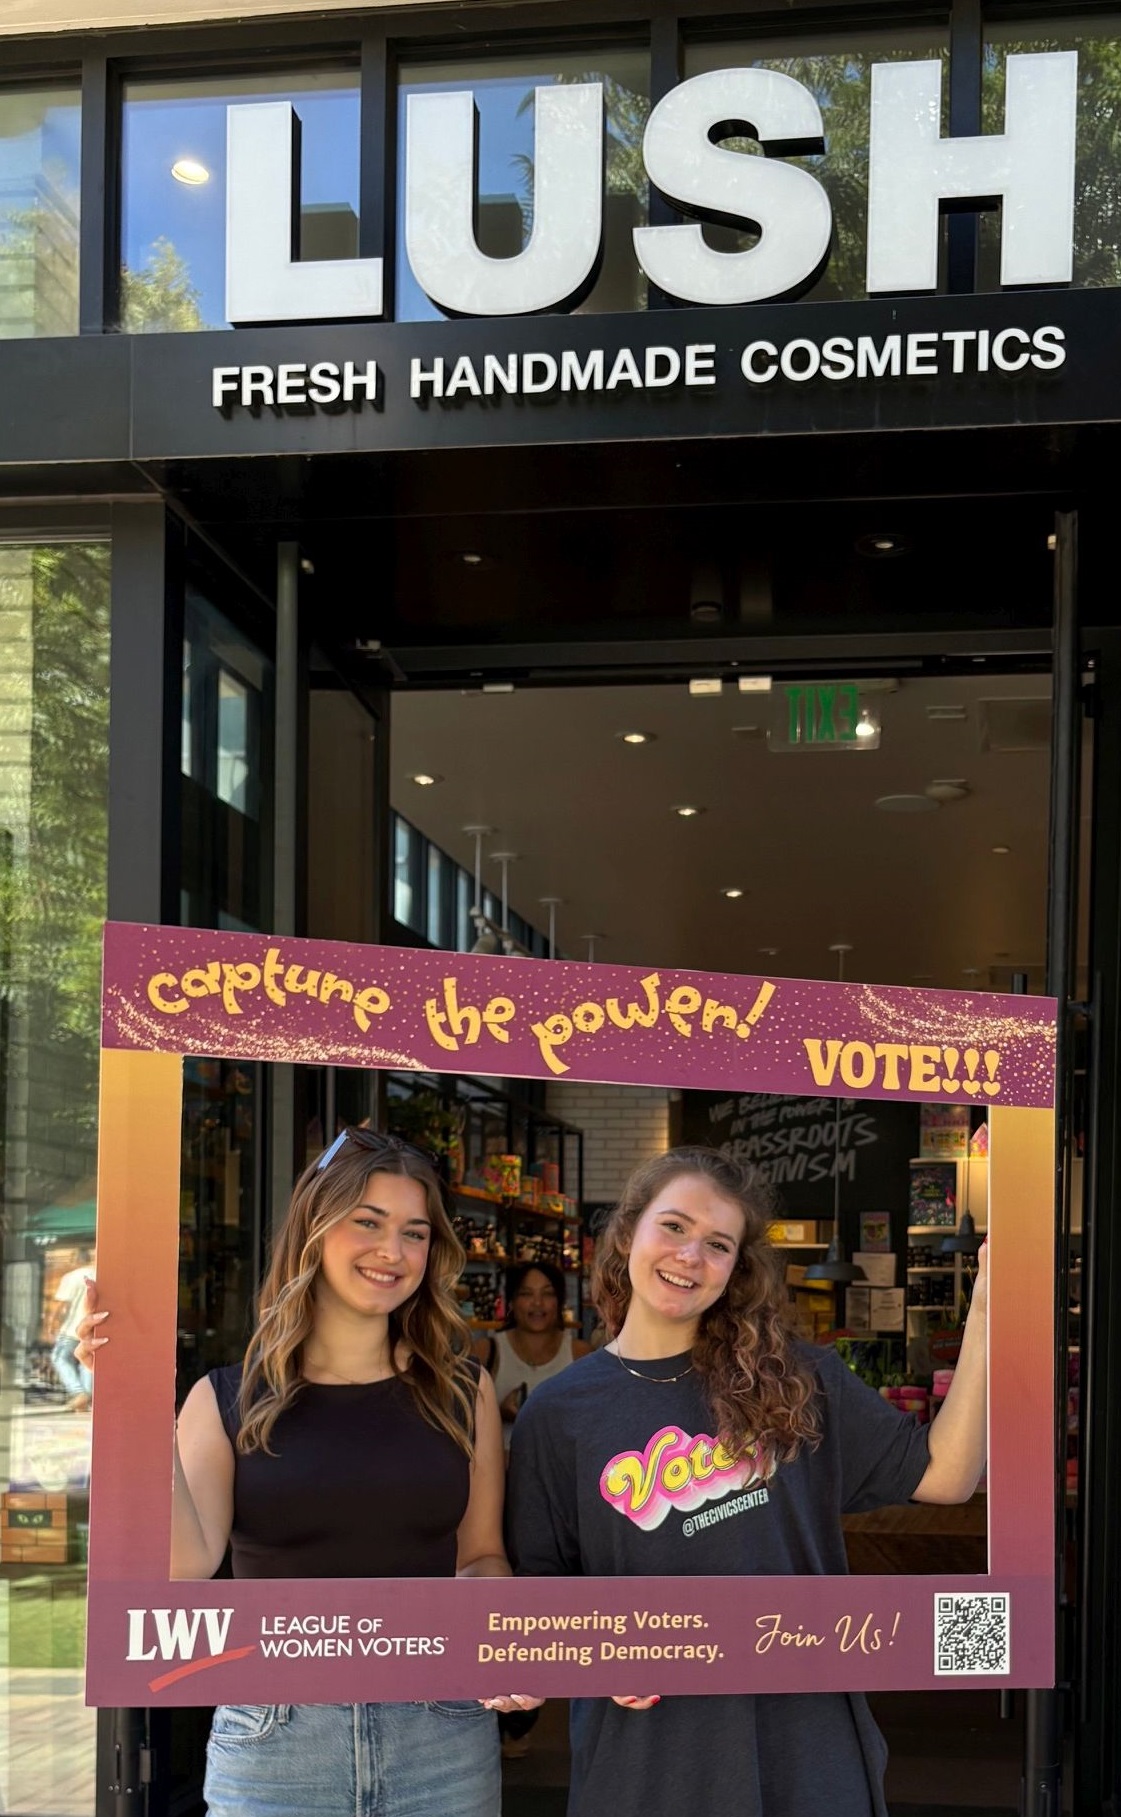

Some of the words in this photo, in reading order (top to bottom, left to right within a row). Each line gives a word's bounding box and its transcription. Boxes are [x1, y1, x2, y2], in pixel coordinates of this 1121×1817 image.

[226, 50, 1078, 323] LUSH
[212, 360, 377, 407] FRESH
[410, 342, 717, 399] HANDMADE
[740, 325, 1066, 383] COSMETICS
[147, 948, 391, 1033] capture
[425, 976, 516, 1051] the
[531, 972, 776, 1075] power!
[803, 1038, 1001, 1096] VOTE!!!
[778, 1098, 835, 1123] POWER
[720, 1112, 878, 1159] GRASSROOTS
[748, 1149, 857, 1184] CTIVISM
[682, 1487, 770, 1537] @THECIVICSCENTER
[125, 1608, 235, 1661] LWV
[260, 1615, 350, 1635] LEAGUE
[357, 1618, 383, 1634] OF
[488, 1610, 628, 1636] Empowering
[633, 1610, 710, 1629] Voters.
[754, 1613, 826, 1654] Join
[834, 1611, 901, 1654] Us!
[259, 1638, 353, 1658] WOMEN
[357, 1636, 447, 1657] VOTERS
[477, 1641, 594, 1666] Defending
[599, 1641, 725, 1664] Democracy.
